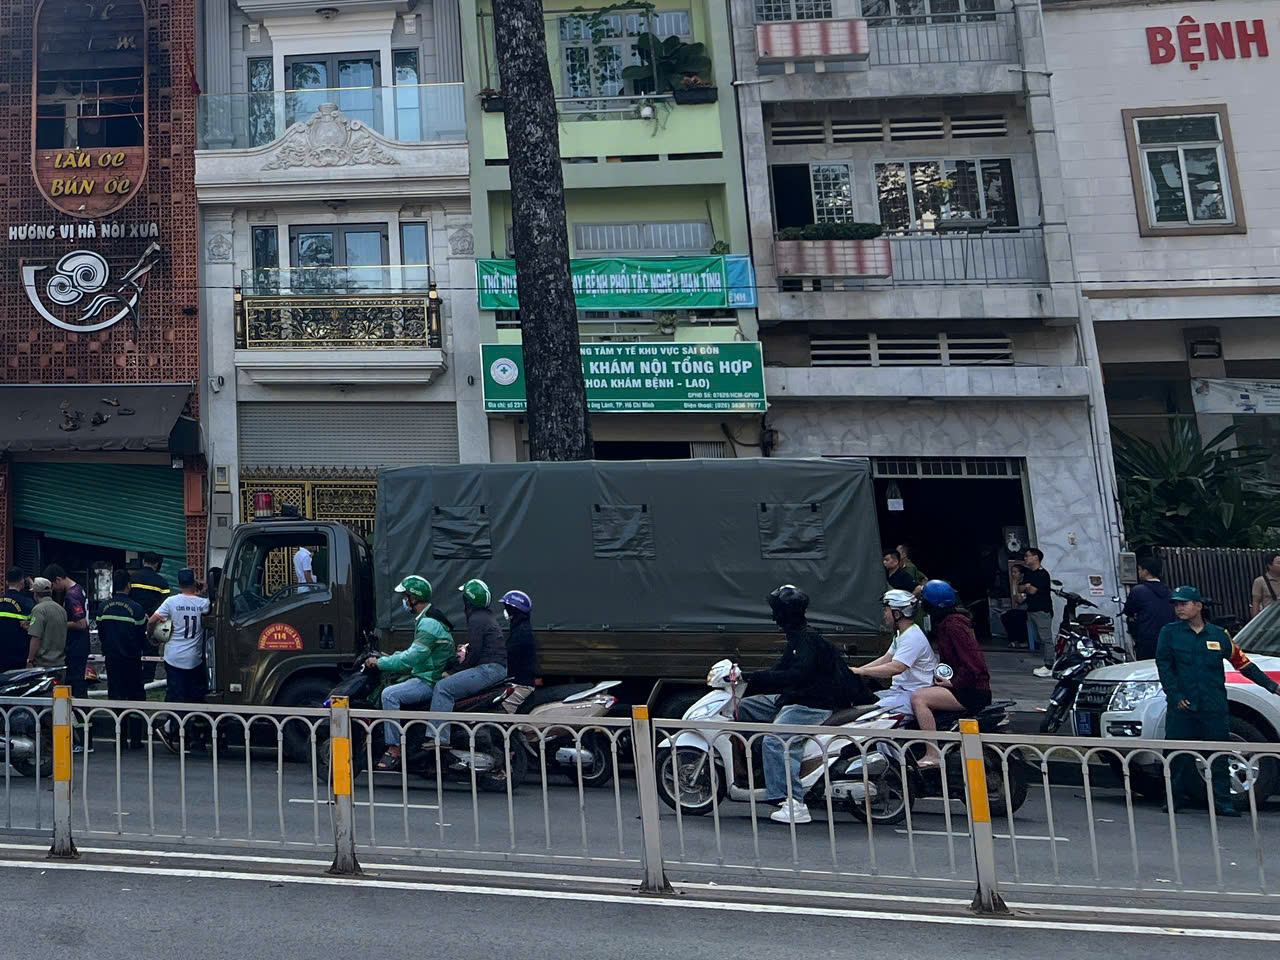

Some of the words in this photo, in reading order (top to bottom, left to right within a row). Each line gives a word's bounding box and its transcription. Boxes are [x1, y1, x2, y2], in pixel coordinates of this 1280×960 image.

[1145, 15, 1269, 71] BỆNH
[50, 175, 95, 197] BÚN
[104, 172, 131, 194] ỐC
[9, 223, 55, 241] HƯƠNG
[59, 224, 75, 243] VỊ
[78, 220, 97, 239] HÀ
[130, 221, 159, 238] XƯA
[572, 275, 583, 294] AY
[585, 269, 609, 298] BỆNH
[610, 264, 630, 294] PHỔI
[680, 272, 700, 297] MẠN
[701, 268, 722, 293] TÍNH
[594, 346, 614, 356] TÂM
[616, 347, 623, 356] Y
[625, 344, 636, 355] TẾ
[638, 347, 658, 356] KHU
[660, 347, 680, 357] VỰC
[682, 345, 697, 355] SÀI
[699, 345, 719, 355] GÒN
[589, 359, 635, 374] KHÁM
[639, 359, 668, 377] NỘI
[672, 356, 714, 374] TỔNG
[719, 360, 753, 377] HỢP
[585, 378, 608, 389] HOA
[610, 377, 643, 389] KHÁM
[645, 377, 674, 390] BỆNH
[685, 378, 710, 390] LAO)
[409, 587, 423, 597] Grab
[183, 615, 198, 639] 11
[273, 632, 287, 640] 114
